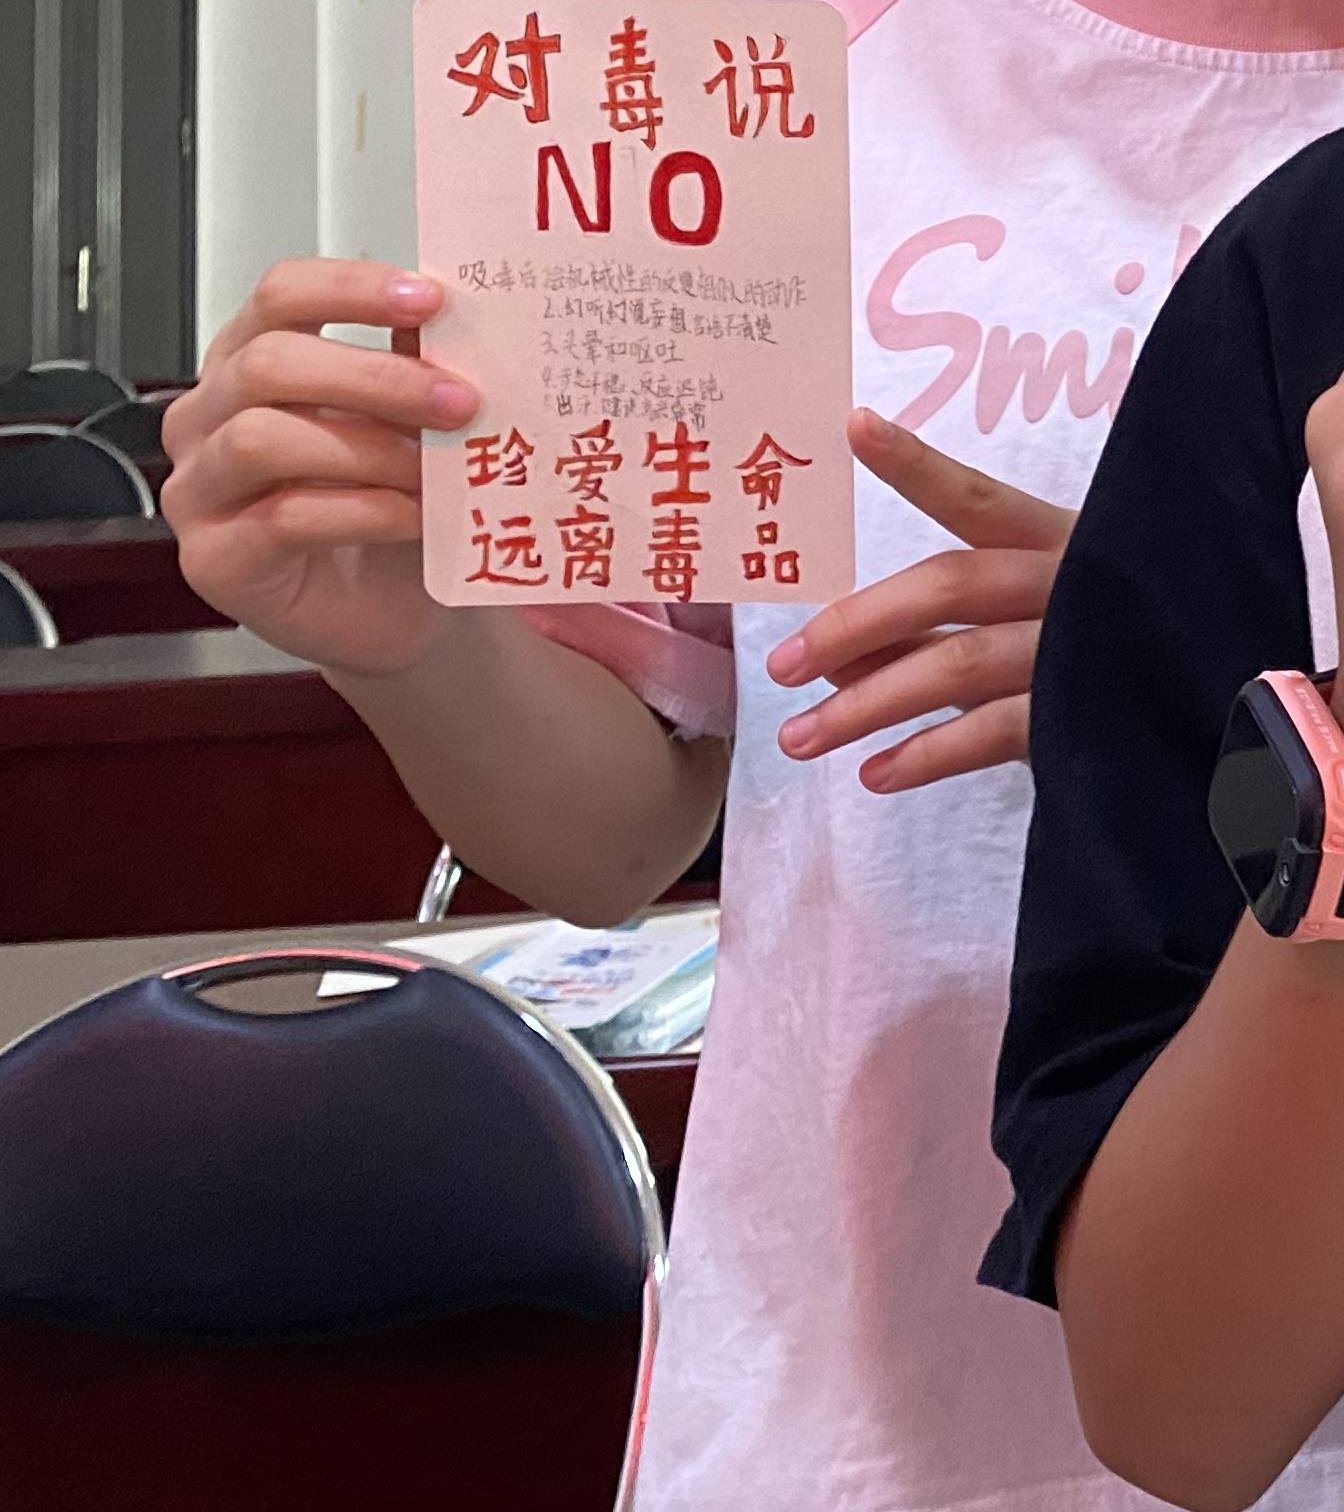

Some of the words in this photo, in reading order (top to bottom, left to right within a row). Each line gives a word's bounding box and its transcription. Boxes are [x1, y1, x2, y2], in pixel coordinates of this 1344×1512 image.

[447, 12, 814, 149] 对毒说
[537, 141, 722, 245] NO
[465, 419, 813, 510] 珍爱生命
[465, 504, 800, 601] 远离毒品
